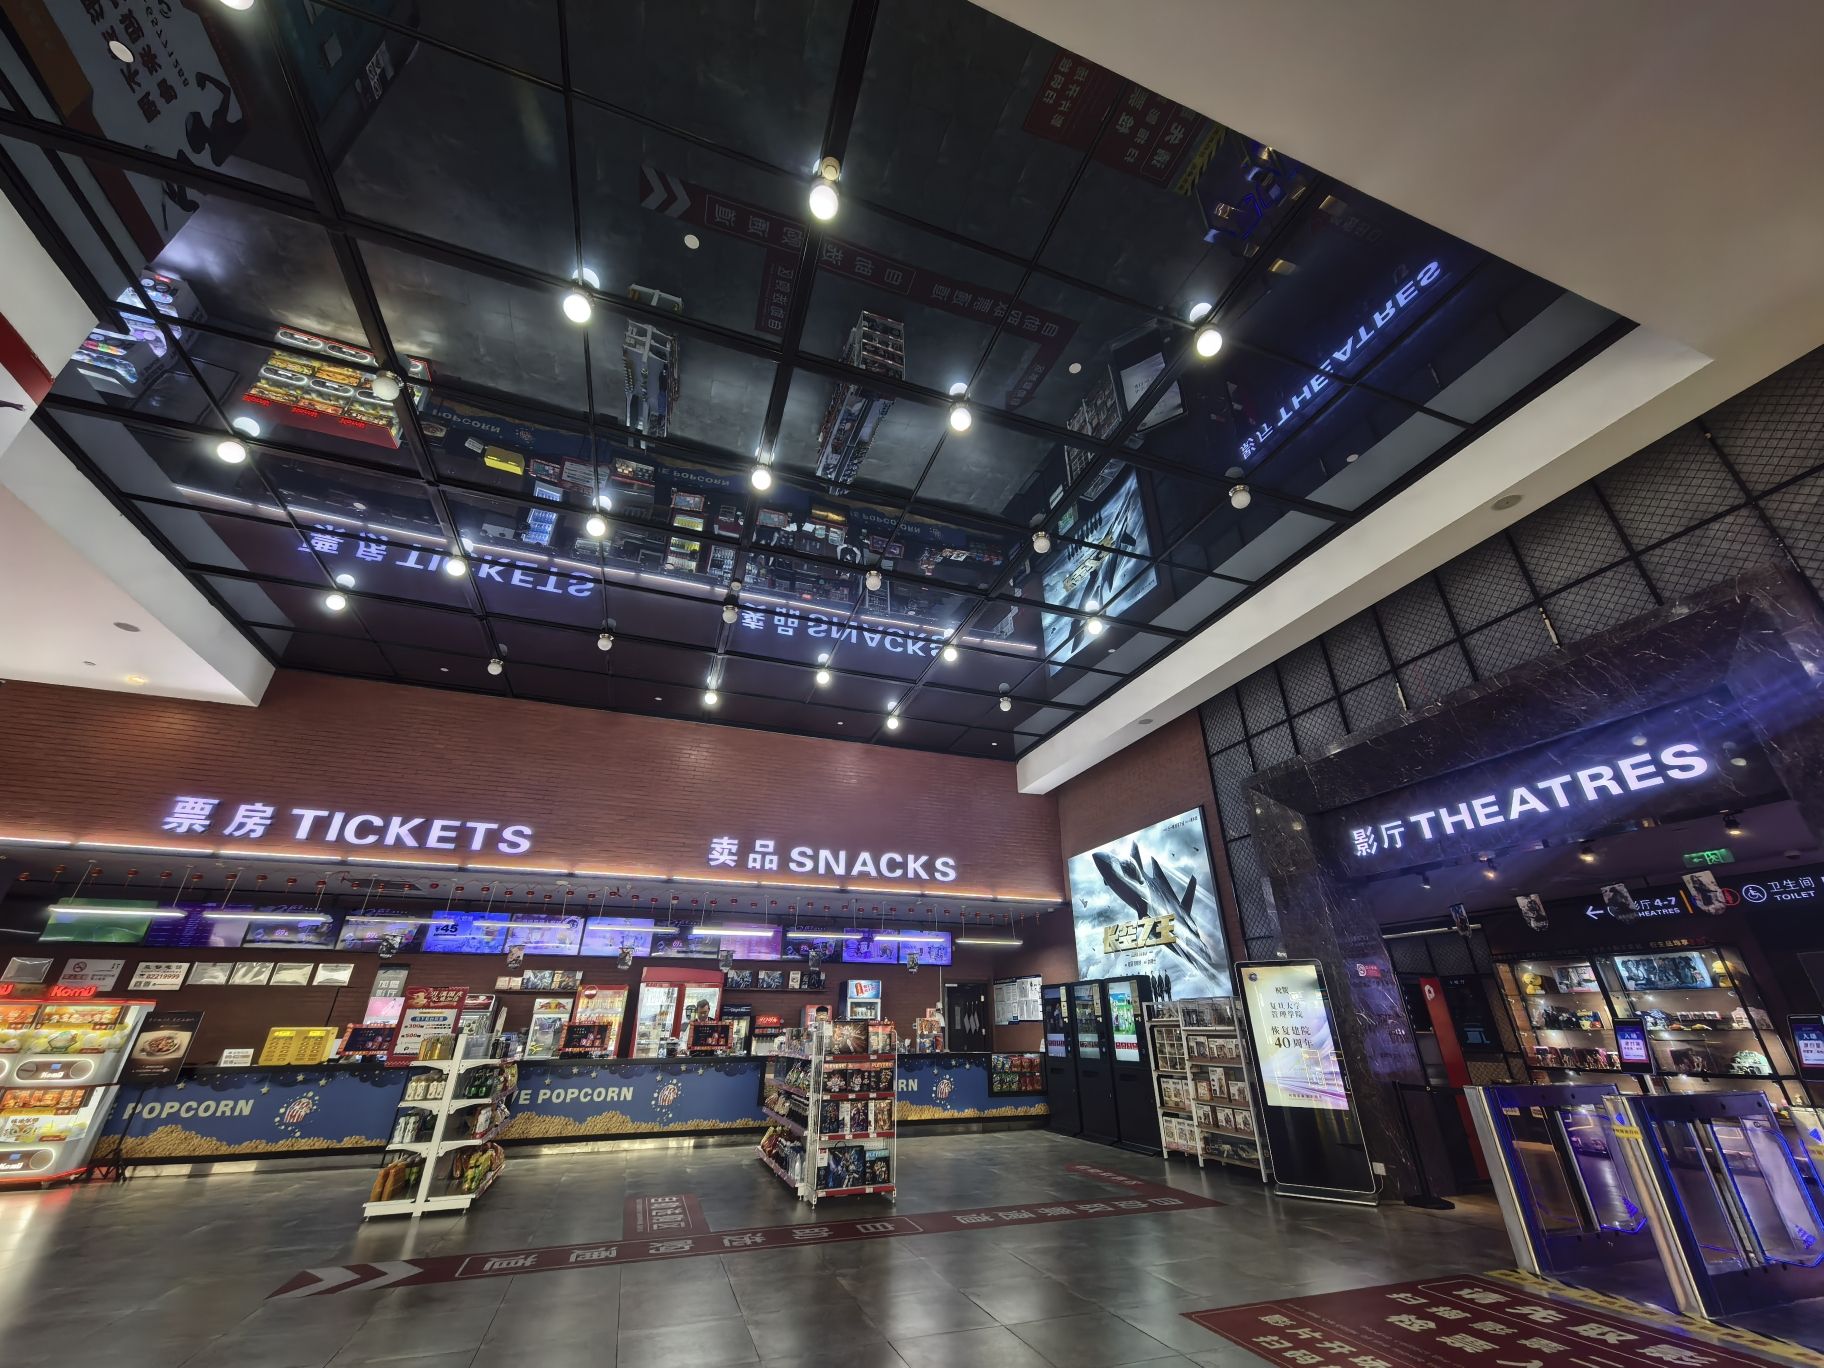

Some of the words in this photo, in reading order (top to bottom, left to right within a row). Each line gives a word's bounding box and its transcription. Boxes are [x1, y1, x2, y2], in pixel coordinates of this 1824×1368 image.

[1352, 819, 1406, 858] 影厅
[1409, 743, 1710, 840] THEATRES
[161, 795, 277, 840] 票房
[290, 807, 534, 855] TICKETS
[708, 835, 779, 872] 卖品
[788, 846, 958, 882] SNACKS
[1767, 876, 1815, 893] 卫生间
[1655, 897, 1677, 908] 4-7
[1774, 890, 1816, 902] TOILET
[537, 1086, 634, 1104] POPCORN
[122, 1099, 254, 1120] POPCORN
